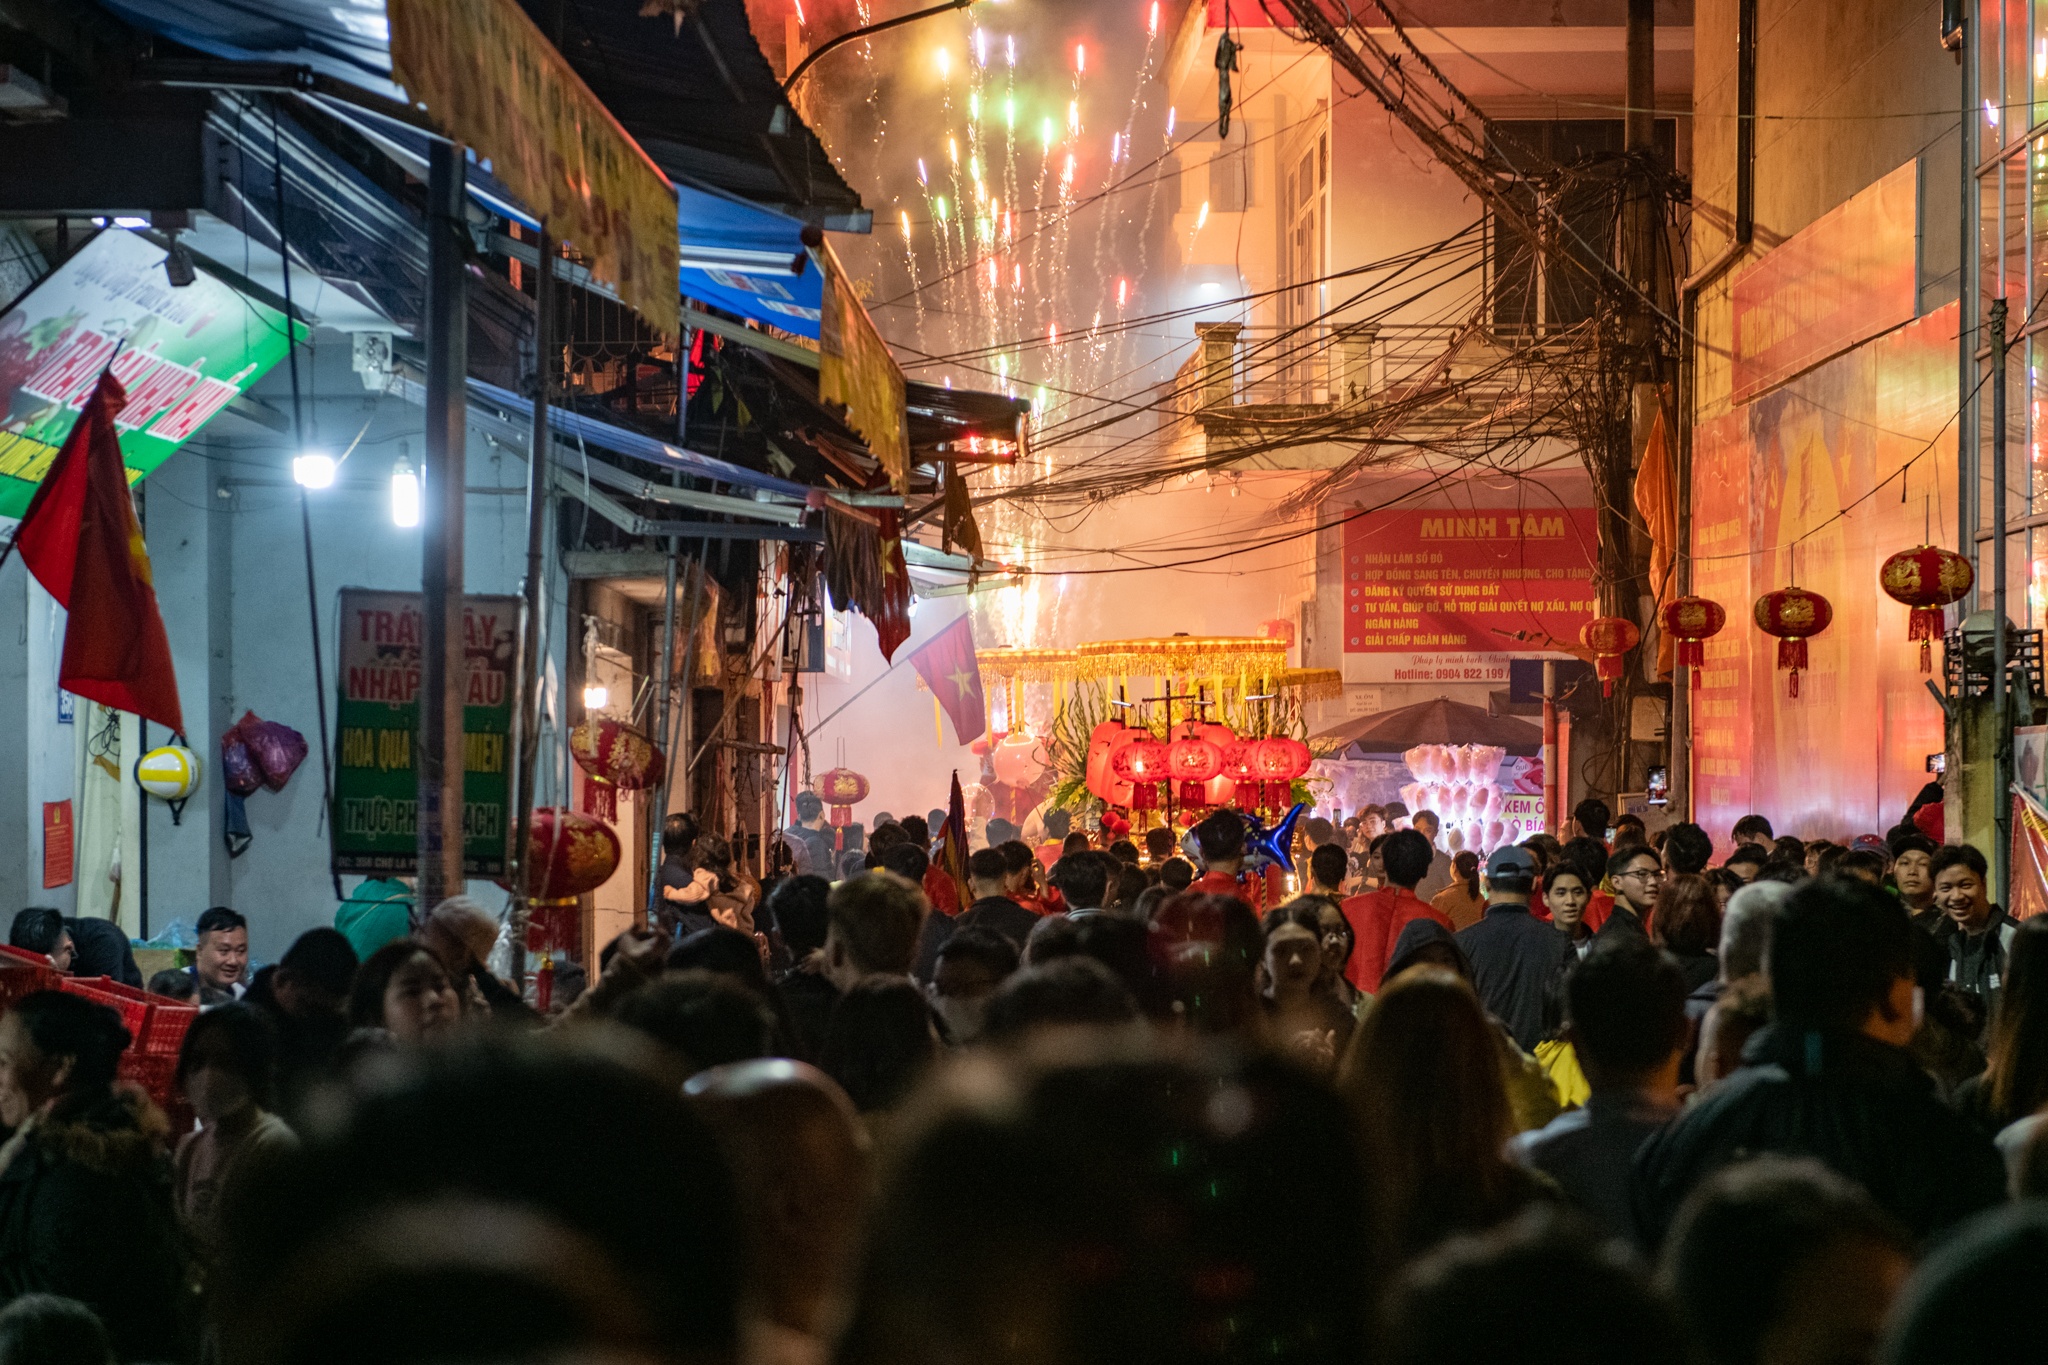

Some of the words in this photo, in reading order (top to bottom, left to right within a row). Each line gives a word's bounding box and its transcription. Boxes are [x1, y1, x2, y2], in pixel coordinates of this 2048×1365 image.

[115, 357, 205, 437] NHẬP
[146, 363, 257, 442] KHẨU
[1420, 517, 1496, 537] MINH
[1507, 513, 1565, 537] TÂM
[1365, 552, 1390, 566] NHẬN
[1394, 552, 1413, 564] LÀM
[1365, 569, 1383, 582] HỢP
[1414, 569, 1438, 580] SANG
[1441, 567, 1461, 581] TÊN,
[1545, 568, 1564, 578] CHO
[1393, 585, 1404, 596] KÝ
[1454, 585, 1479, 598] DỤNG
[1482, 582, 1499, 596] ĐẤT
[1365, 602, 1377, 613] TƯ
[1379, 599, 1400, 613] VẤN,
[1402, 601, 1424, 613] GIÚP
[1459, 601, 1477, 614] TRỢ
[1479, 599, 1497, 612] GIẢI
[1500, 598, 1528, 612] QUYẾT
[1531, 600, 1544, 613] NỢ
[1546, 598, 1568, 612] XẤU,
[1570, 600, 1583, 613] NỢ
[463, 607, 497, 647] ÂY
[1365, 617, 1391, 629] NGÂN
[1393, 617, 1418, 629] HÀNG
[1365, 632, 1384, 645] GIẢI
[1386, 632, 1411, 645] CHẤP
[1413, 633, 1439, 645] NGÂN
[1442, 632, 1467, 645] HÀNG
[1445, 654, 1464, 664] minh
[1395, 668, 1433, 680] Hotline:
[1436, 668, 1460, 679] 0904
[1463, 668, 1482, 679] 822
[1485, 668, 1503, 679] 199
[342, 727, 375, 768] HOA
[1504, 800, 1531, 814] KEM
[344, 796, 391, 840] THỰC
[463, 802, 500, 843] ẠCH
